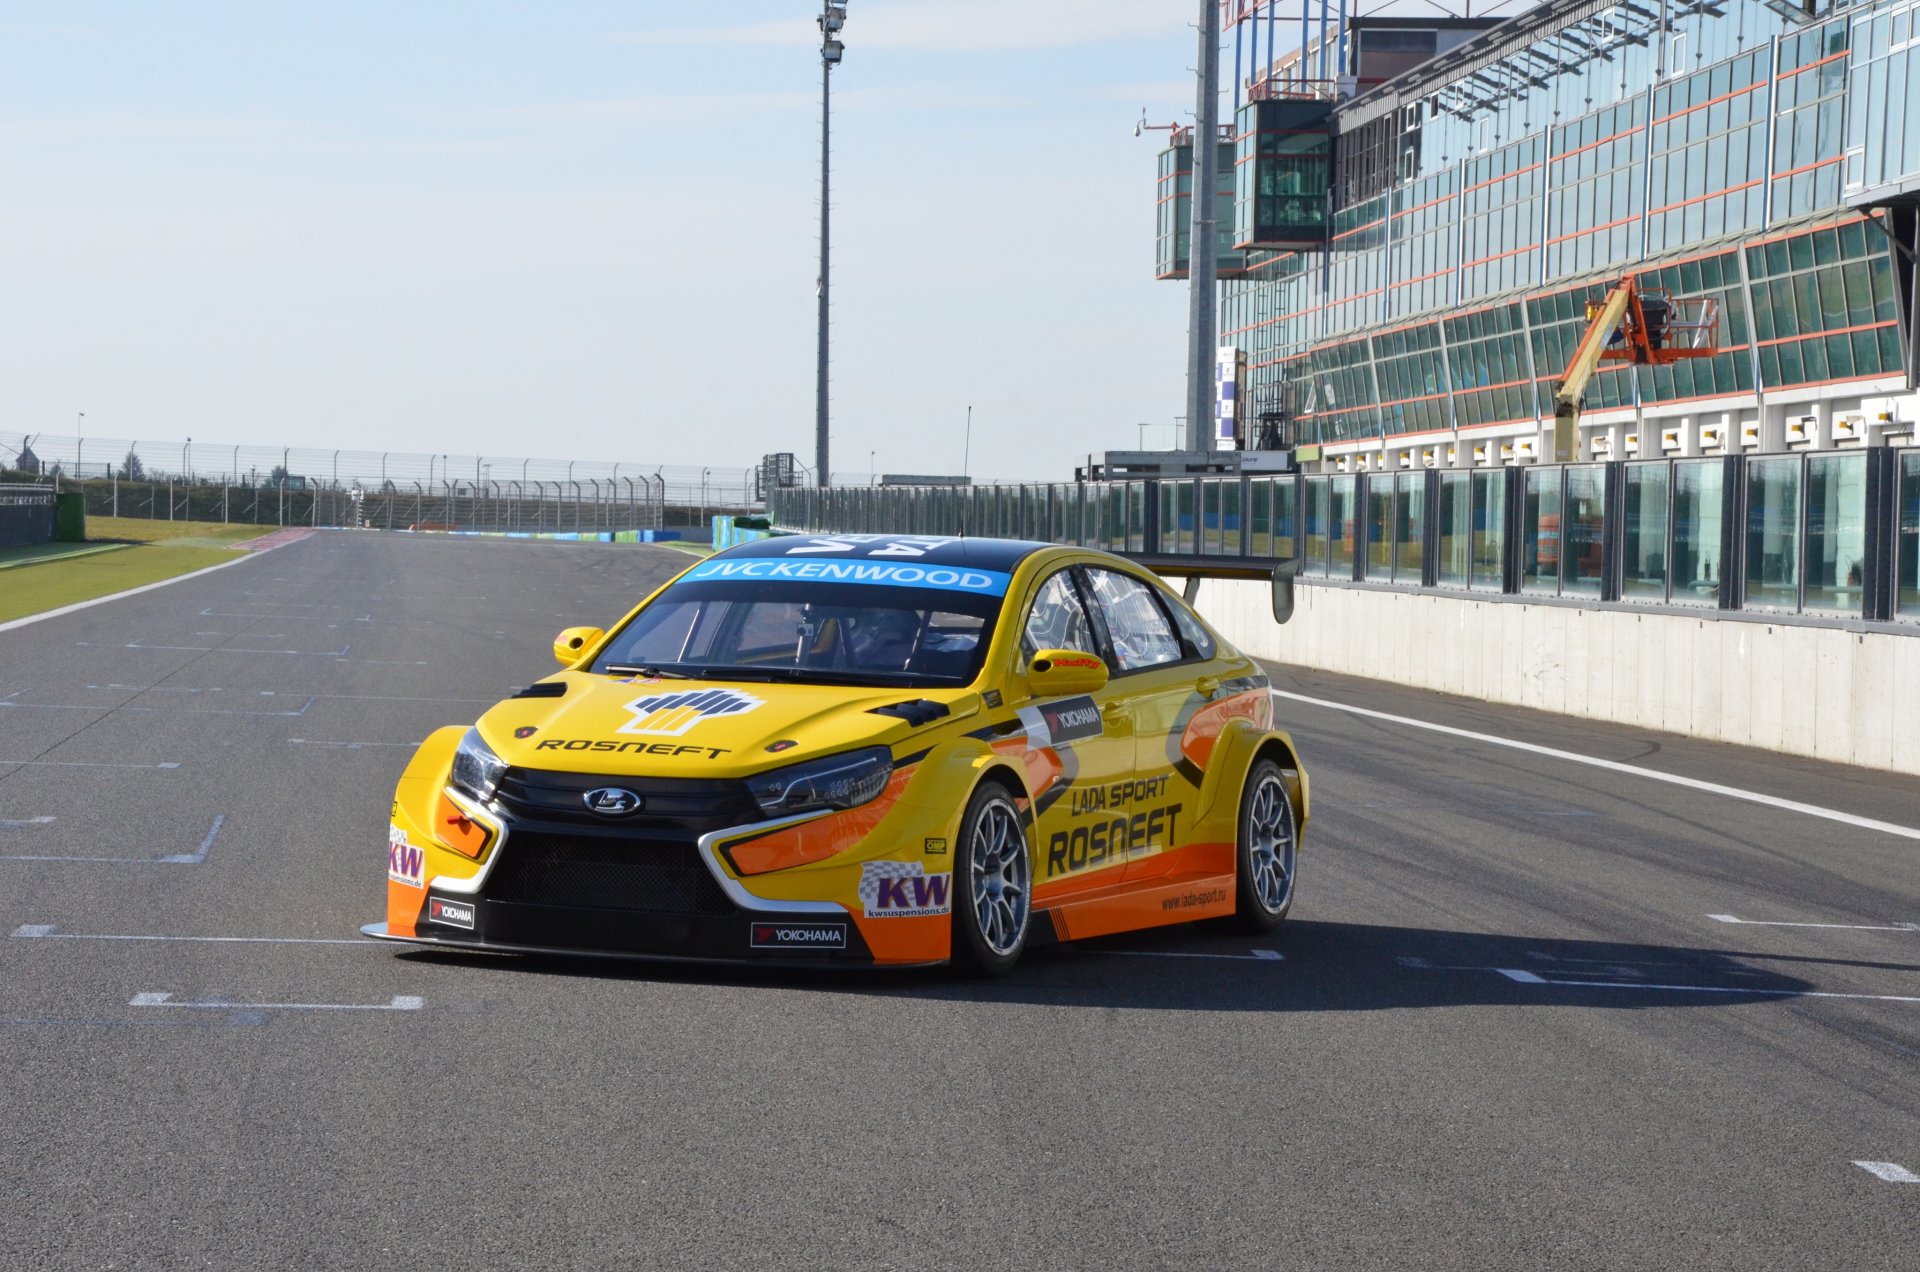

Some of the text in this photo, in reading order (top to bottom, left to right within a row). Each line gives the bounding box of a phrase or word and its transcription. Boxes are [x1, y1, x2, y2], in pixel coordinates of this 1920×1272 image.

[696, 562, 993, 589] JVCKENWOOD
[1056, 707, 1100, 728] YOKOHAMA
[535, 740, 732, 760] ROSNEFT
[1072, 776, 1169, 816] LADA SPORT
[926, 841, 945, 850] OMP
[1047, 803, 1183, 877] ROSNEFT
[389, 841, 423, 878] KW
[877, 874, 950, 909] KW
[1162, 889, 1227, 911] www.lada-sport.ru
[441, 905, 472, 922] YOKOHAMA
[868, 907, 950, 918] kwsuspensions.de
[776, 929, 841, 941] YOKOHAMA
